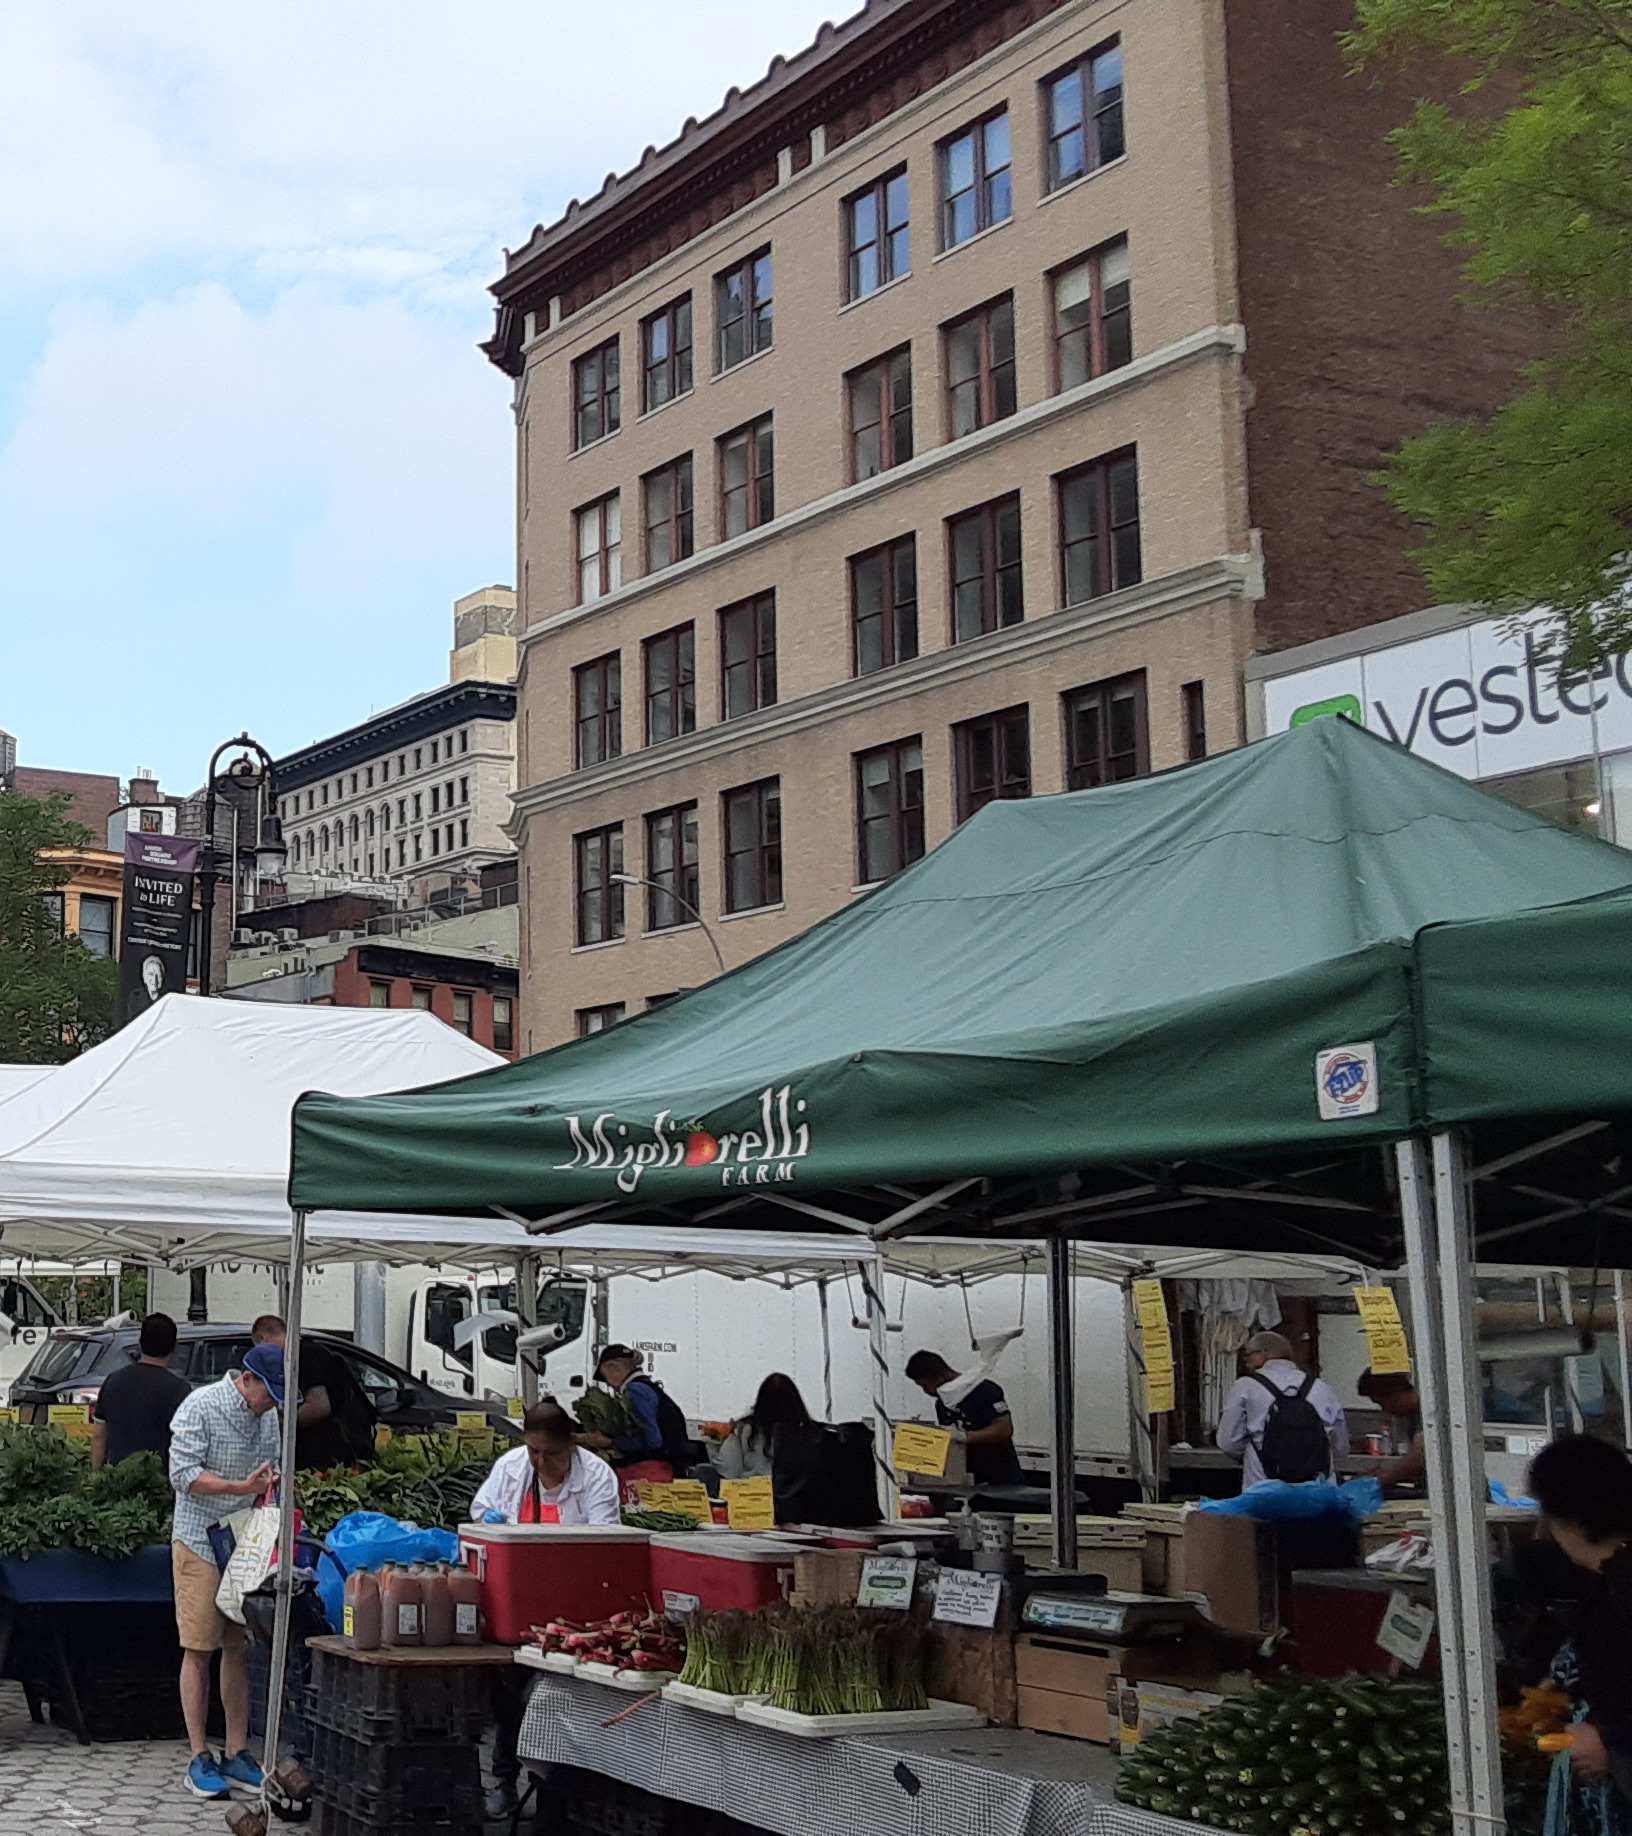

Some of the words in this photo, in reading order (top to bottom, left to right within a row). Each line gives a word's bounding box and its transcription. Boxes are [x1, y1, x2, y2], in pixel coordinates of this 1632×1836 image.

[134, 875, 184, 895] INVITED
[149, 893, 176, 906] LIFE
[721, 1162, 796, 1187] FARM
